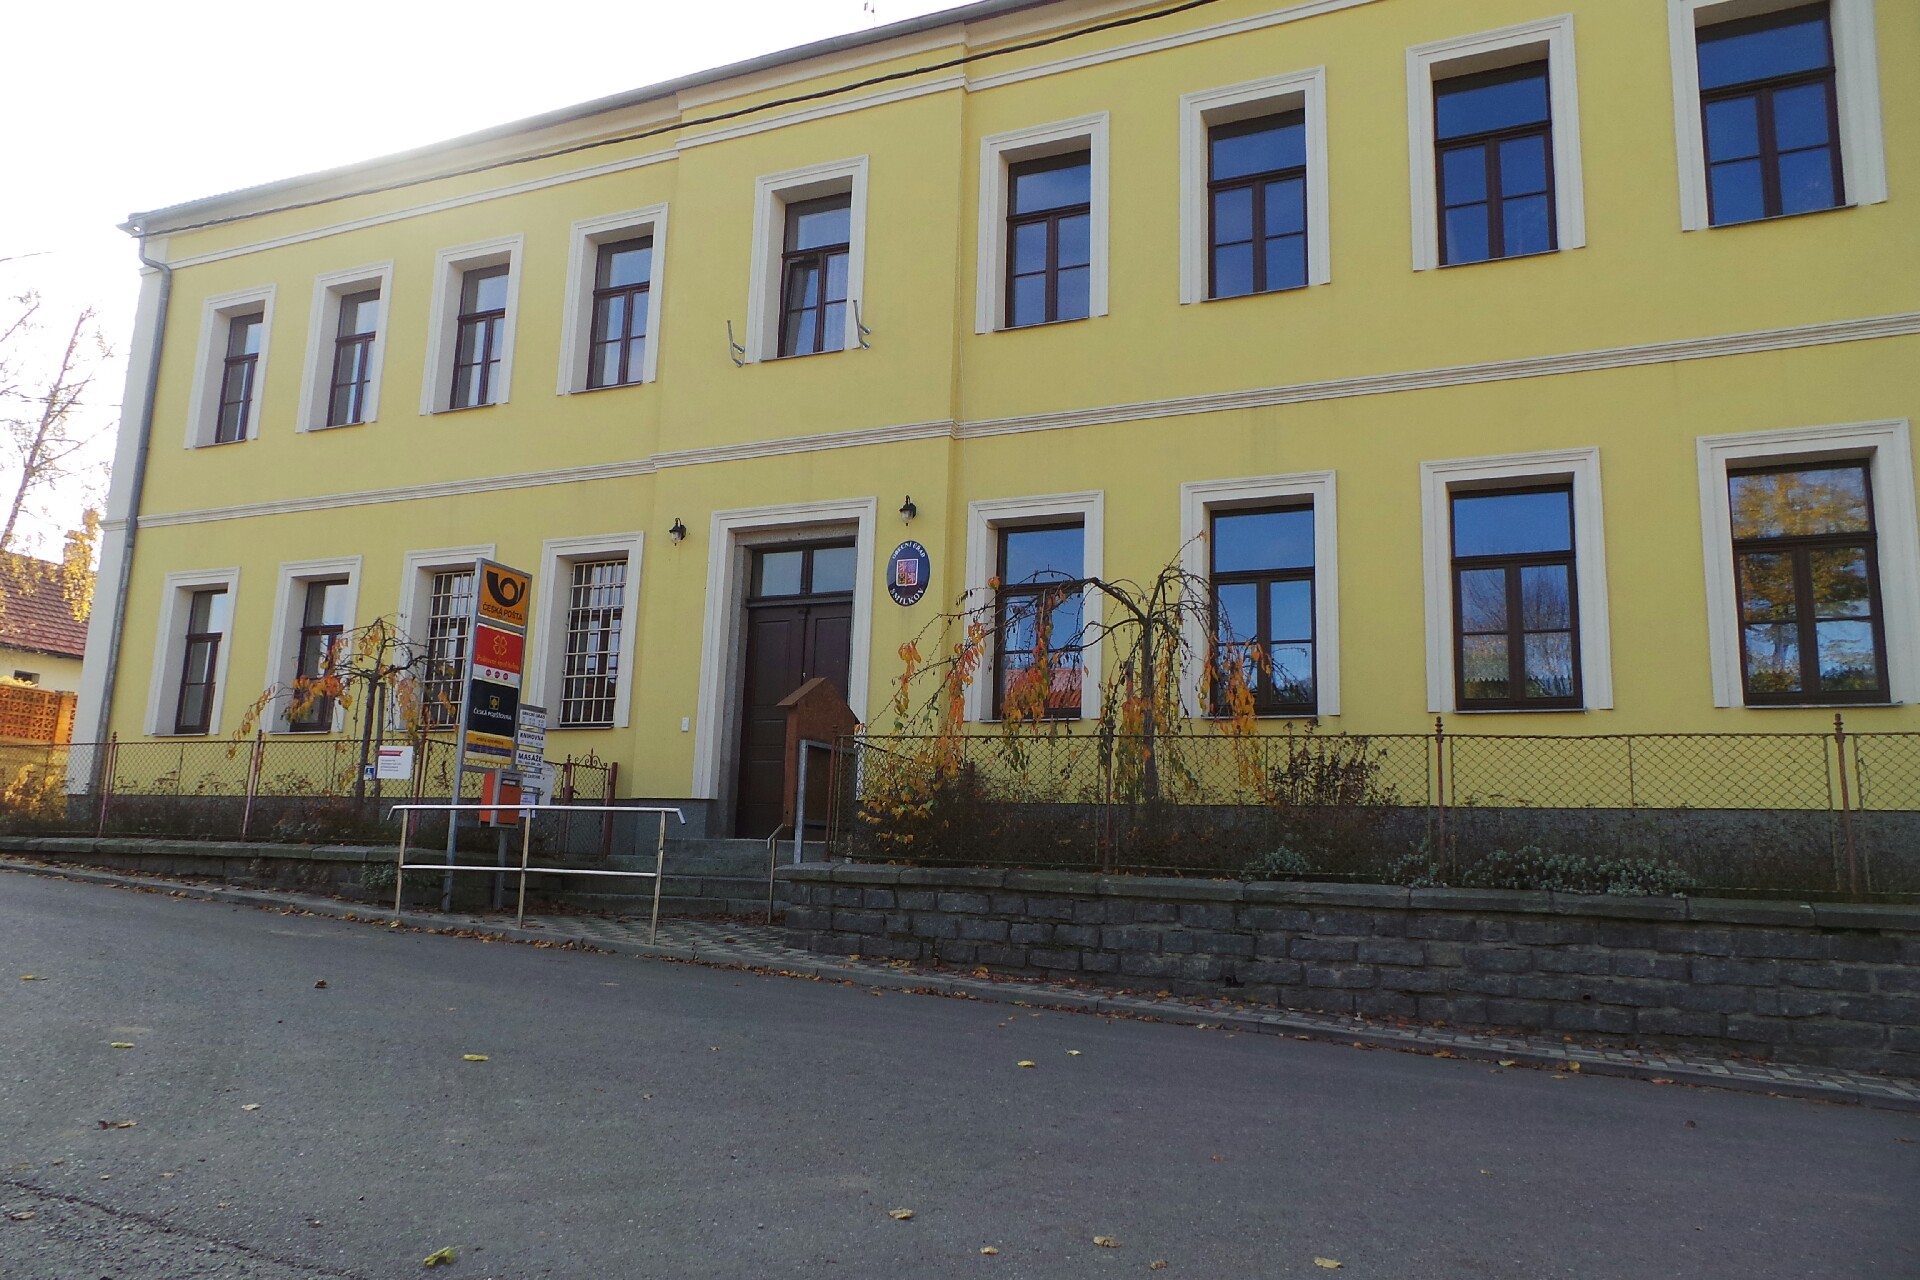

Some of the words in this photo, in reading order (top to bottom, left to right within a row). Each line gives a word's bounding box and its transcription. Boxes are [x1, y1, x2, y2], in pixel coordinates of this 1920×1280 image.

[890, 588, 923, 605] SMILKOV
[482, 602, 502, 615] ČESKÁ
[503, 609, 522, 620] POŠTA
[520, 732, 544, 741] KNIHOVNA
[518, 752, 542, 762] MASÁŽE
